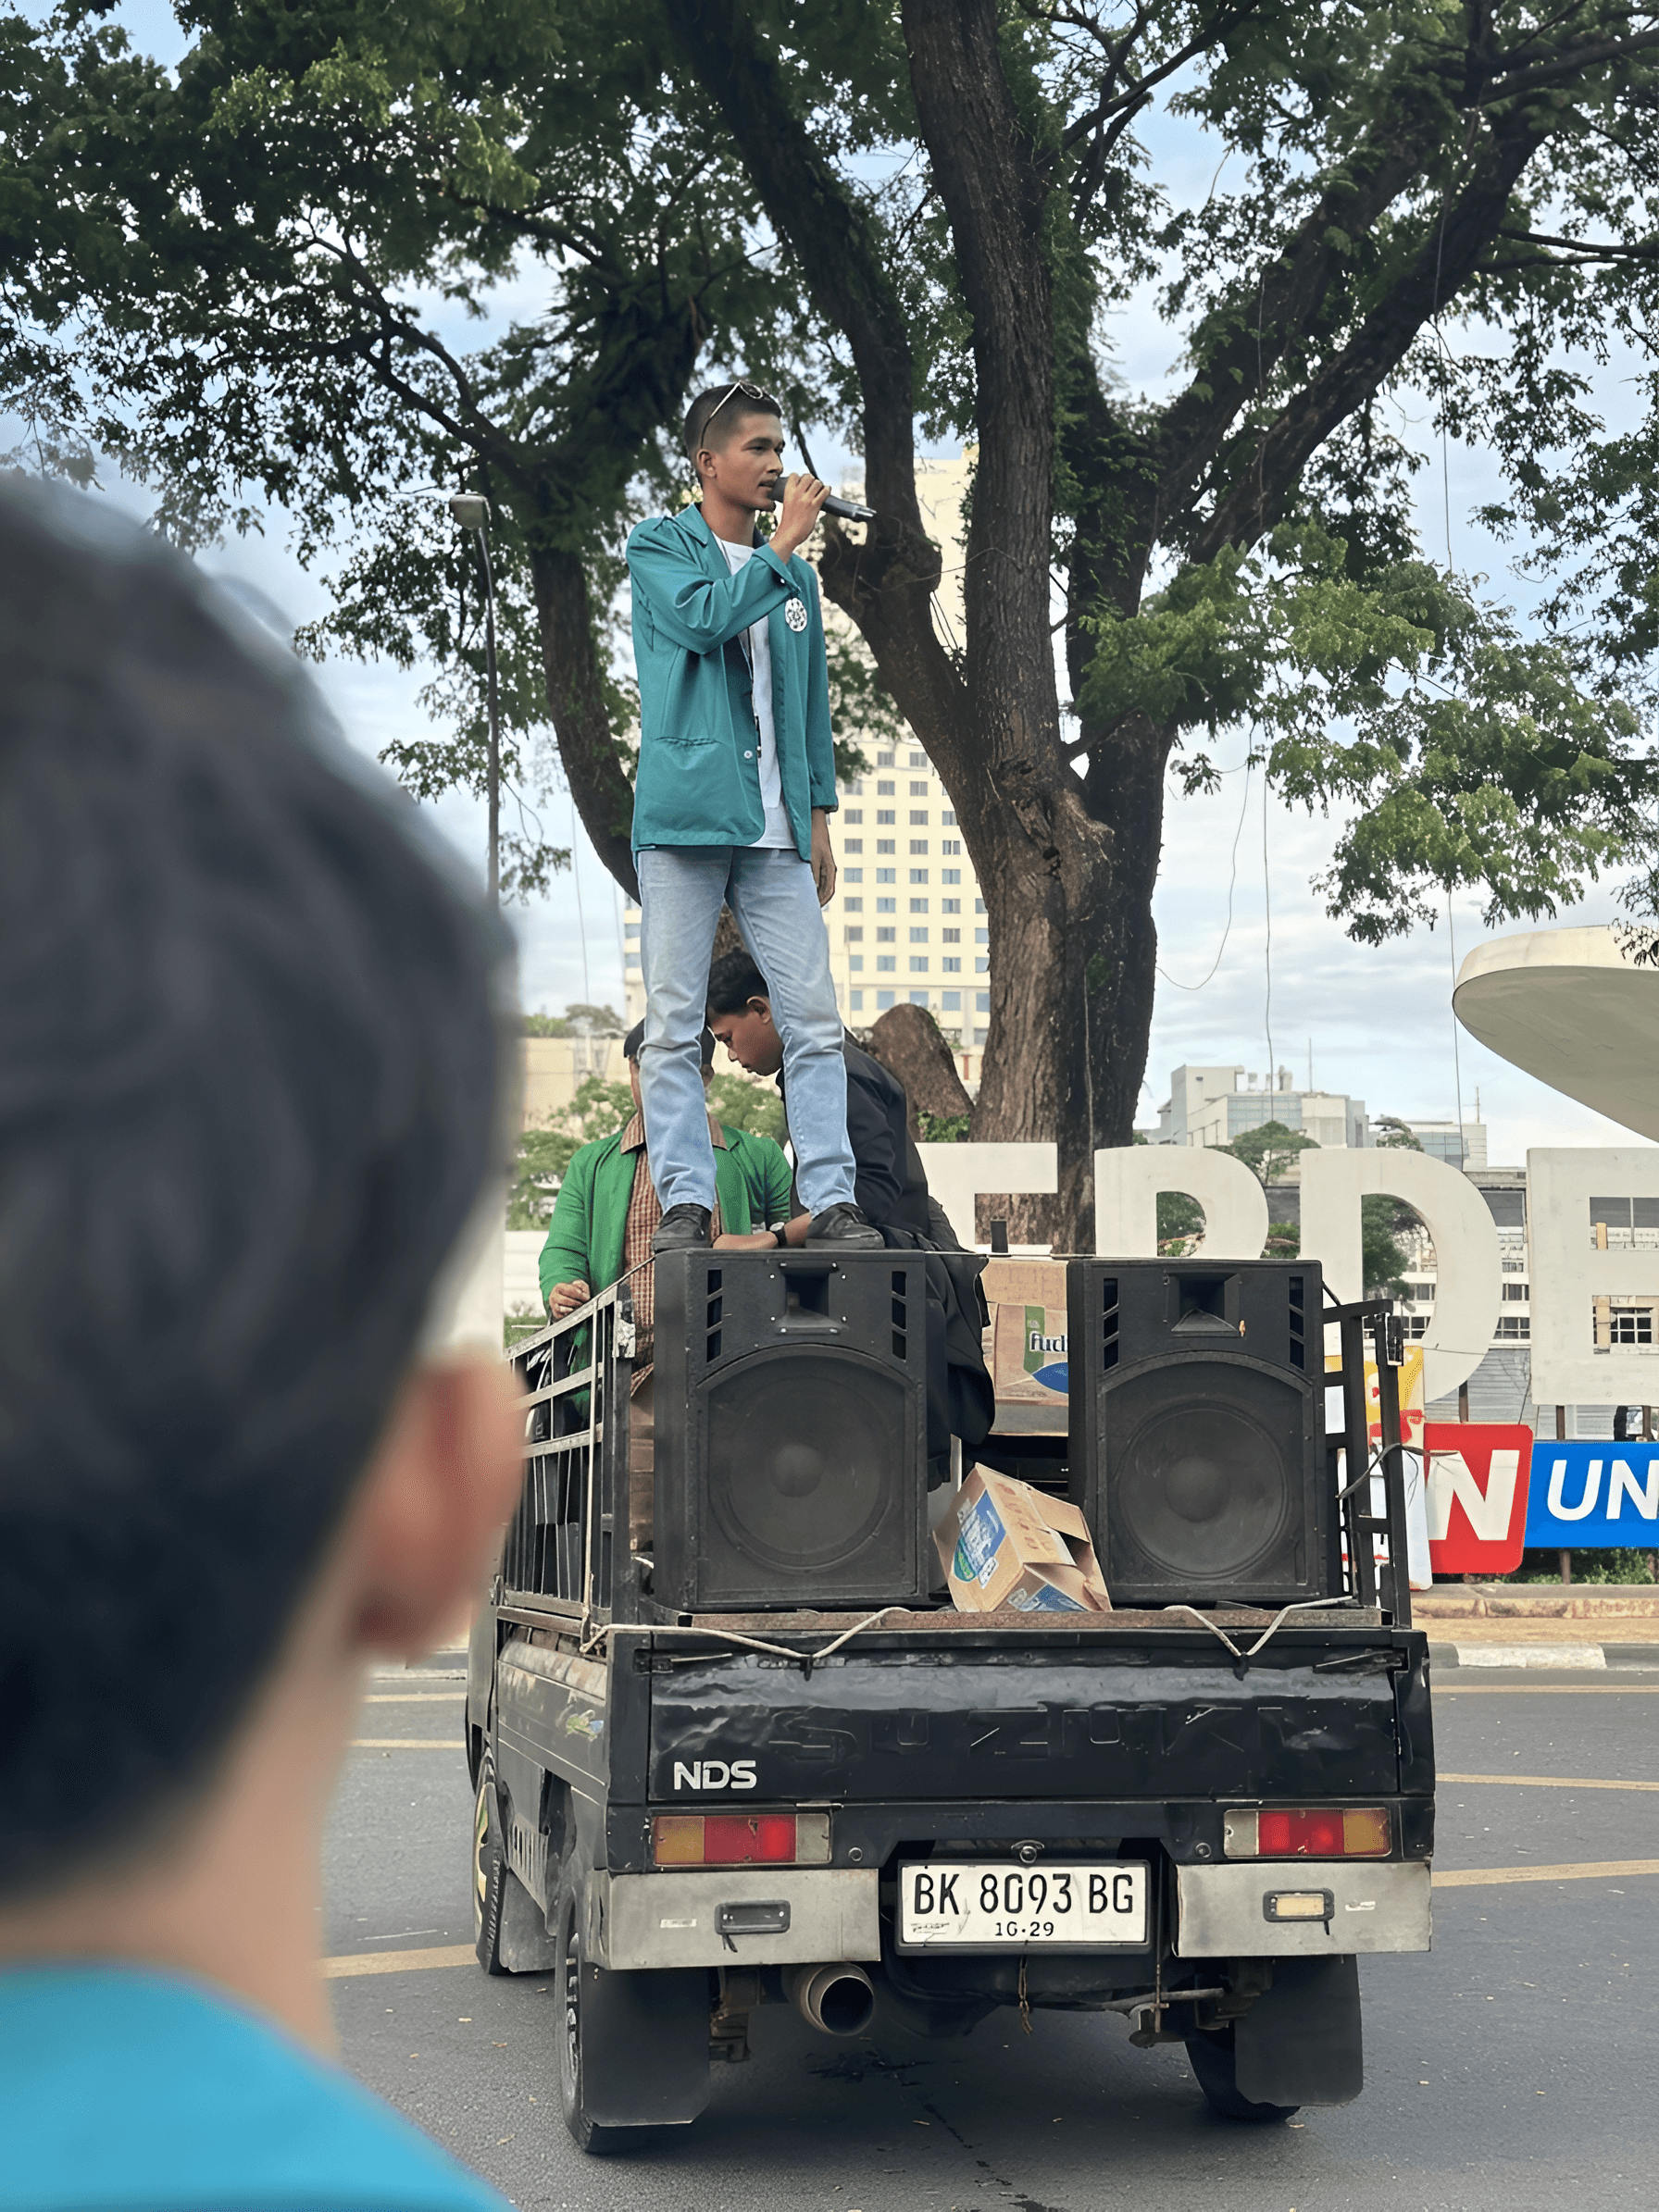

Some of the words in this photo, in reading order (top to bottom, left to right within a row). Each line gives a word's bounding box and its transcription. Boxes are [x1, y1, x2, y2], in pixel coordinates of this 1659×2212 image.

[1547, 1460, 1659, 1521] UN
[673, 1759, 757, 1791] NDS
[914, 1872, 960, 1915] BK
[979, 1872, 1072, 1915] 8093
[1089, 1873, 1133, 1914] BG
